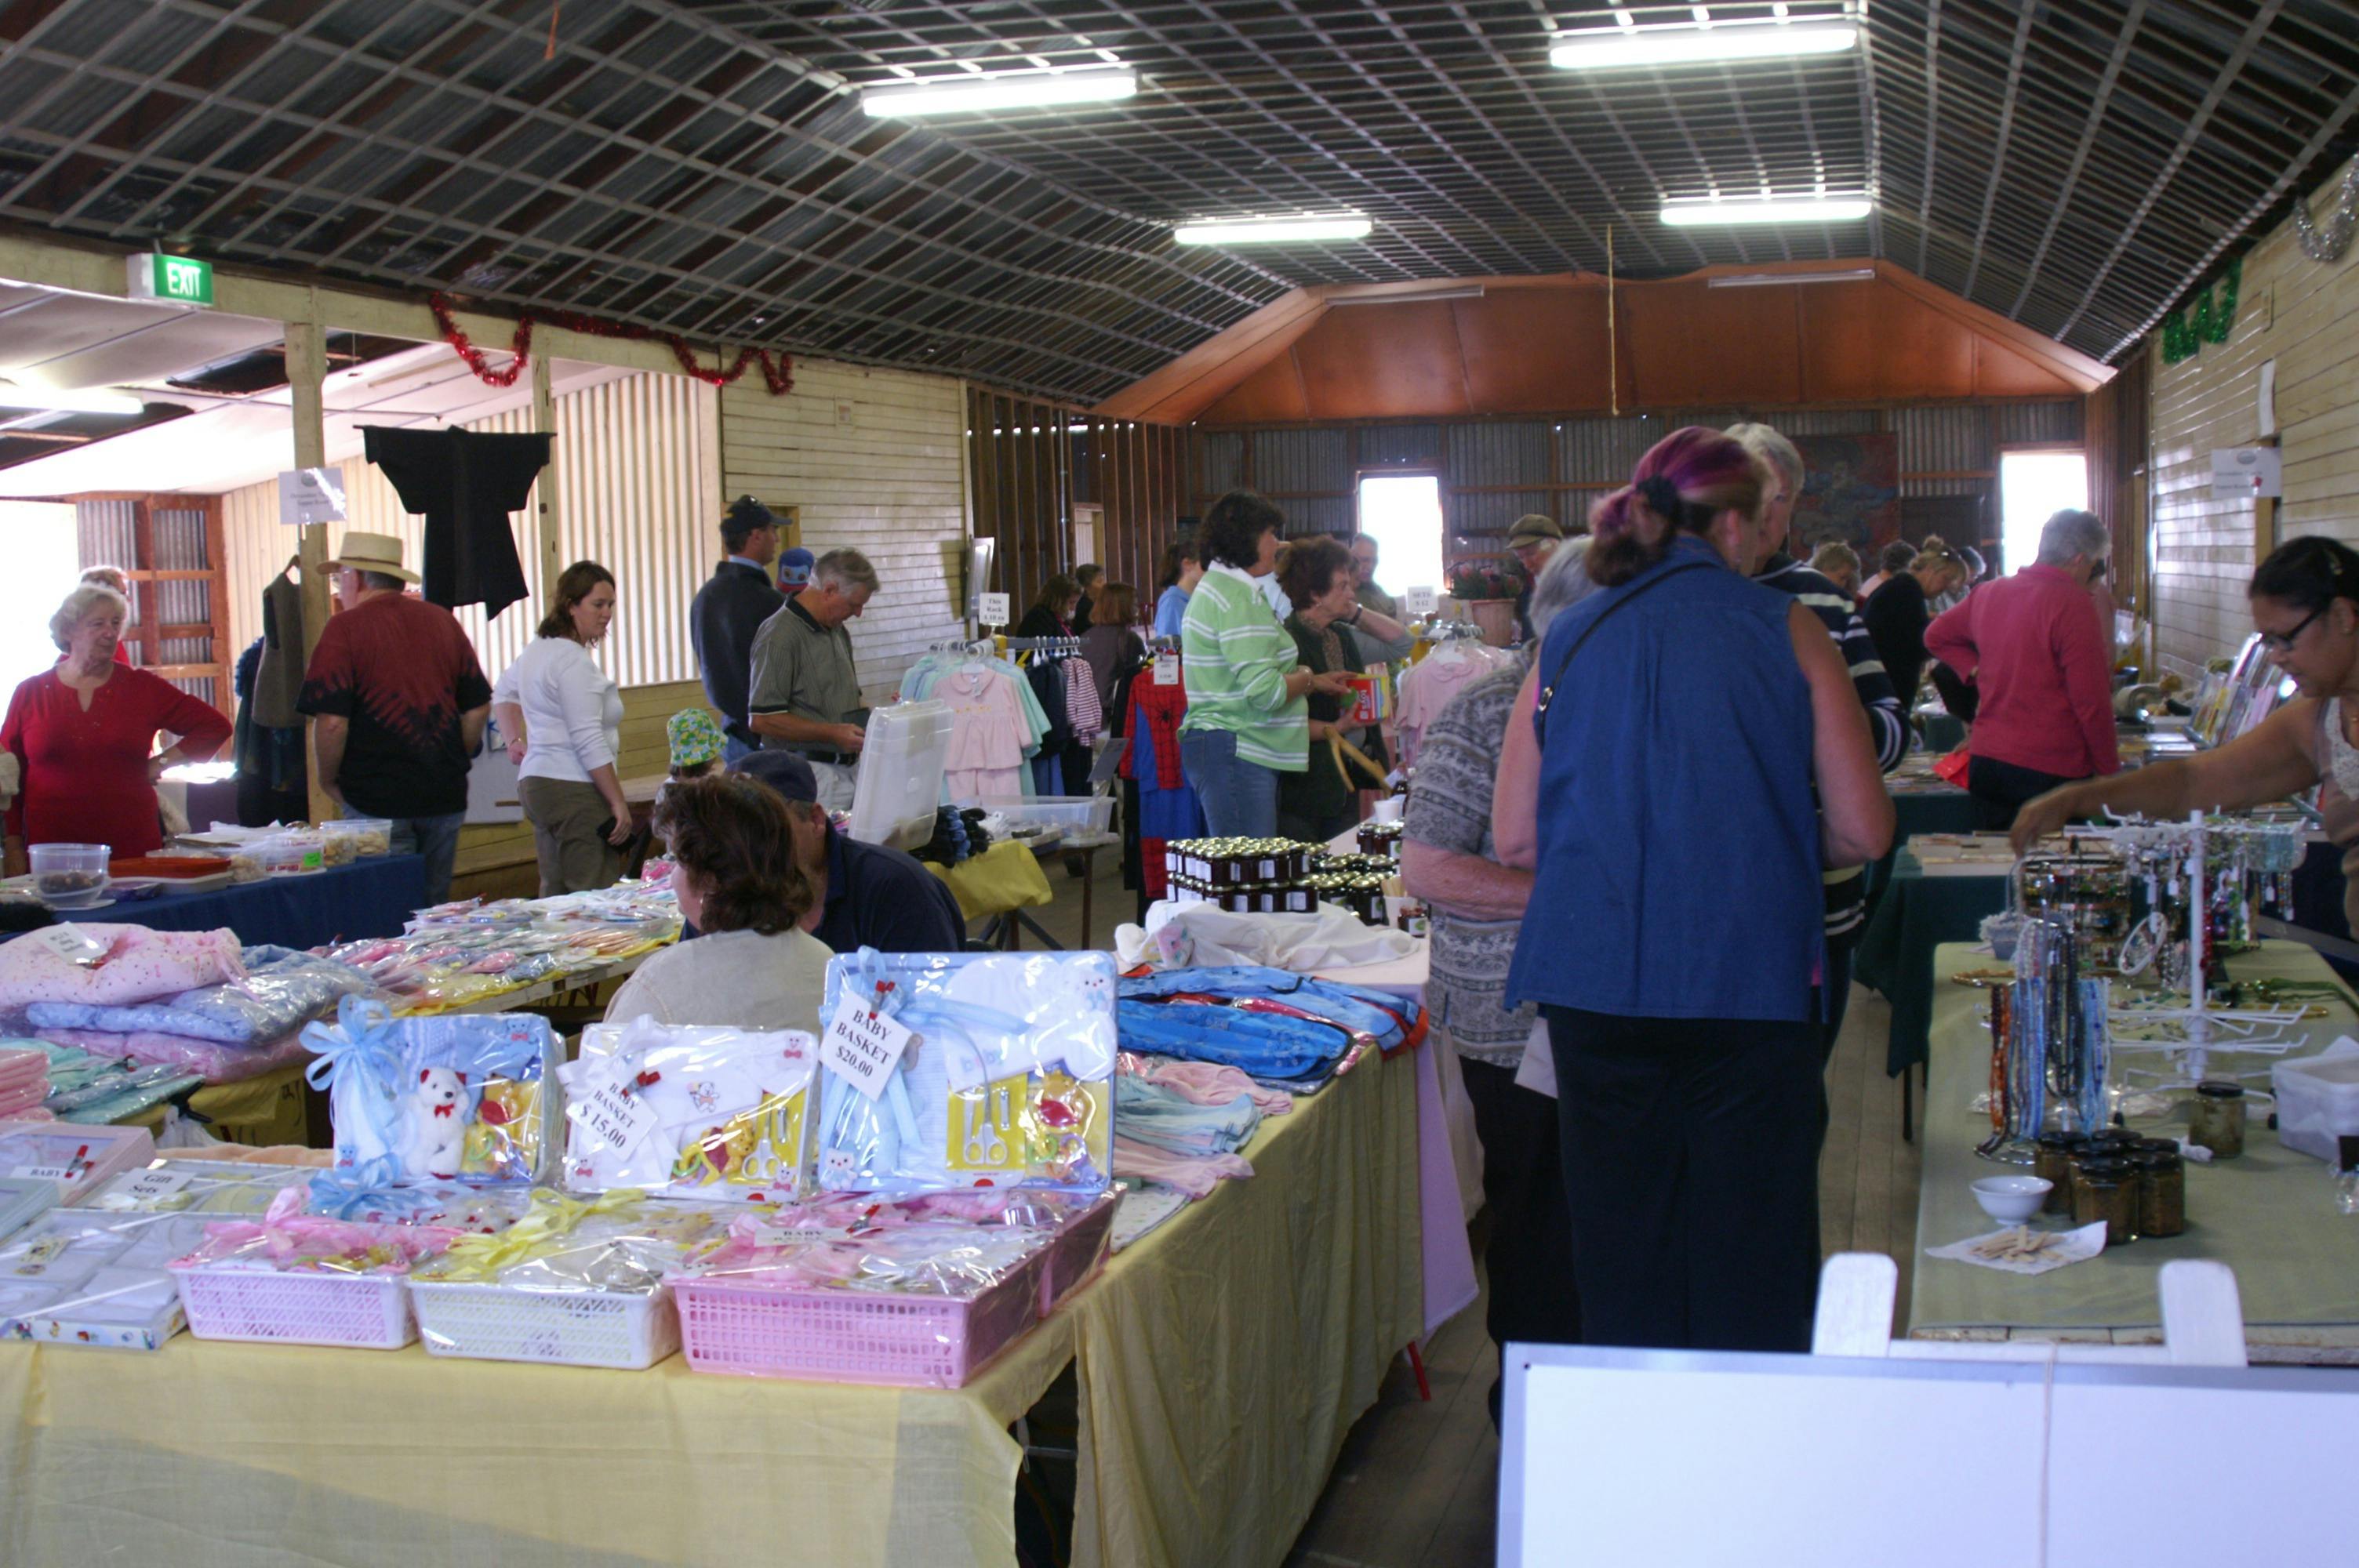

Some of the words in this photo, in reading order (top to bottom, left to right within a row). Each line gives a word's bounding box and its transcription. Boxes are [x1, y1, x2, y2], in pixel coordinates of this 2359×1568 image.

[166, 262, 202, 296] EXIT
[853, 1010, 892, 1040] BABY
[836, 1022, 892, 1065] BASKET
[836, 1045, 873, 1077] $20.00
[594, 1090, 636, 1129] BASKET
[591, 1113, 627, 1148] 15.00
[31, 1168, 60, 1177] BABY
[144, 1174, 173, 1184] Gift
[128, 1185, 159, 1194] Sets
